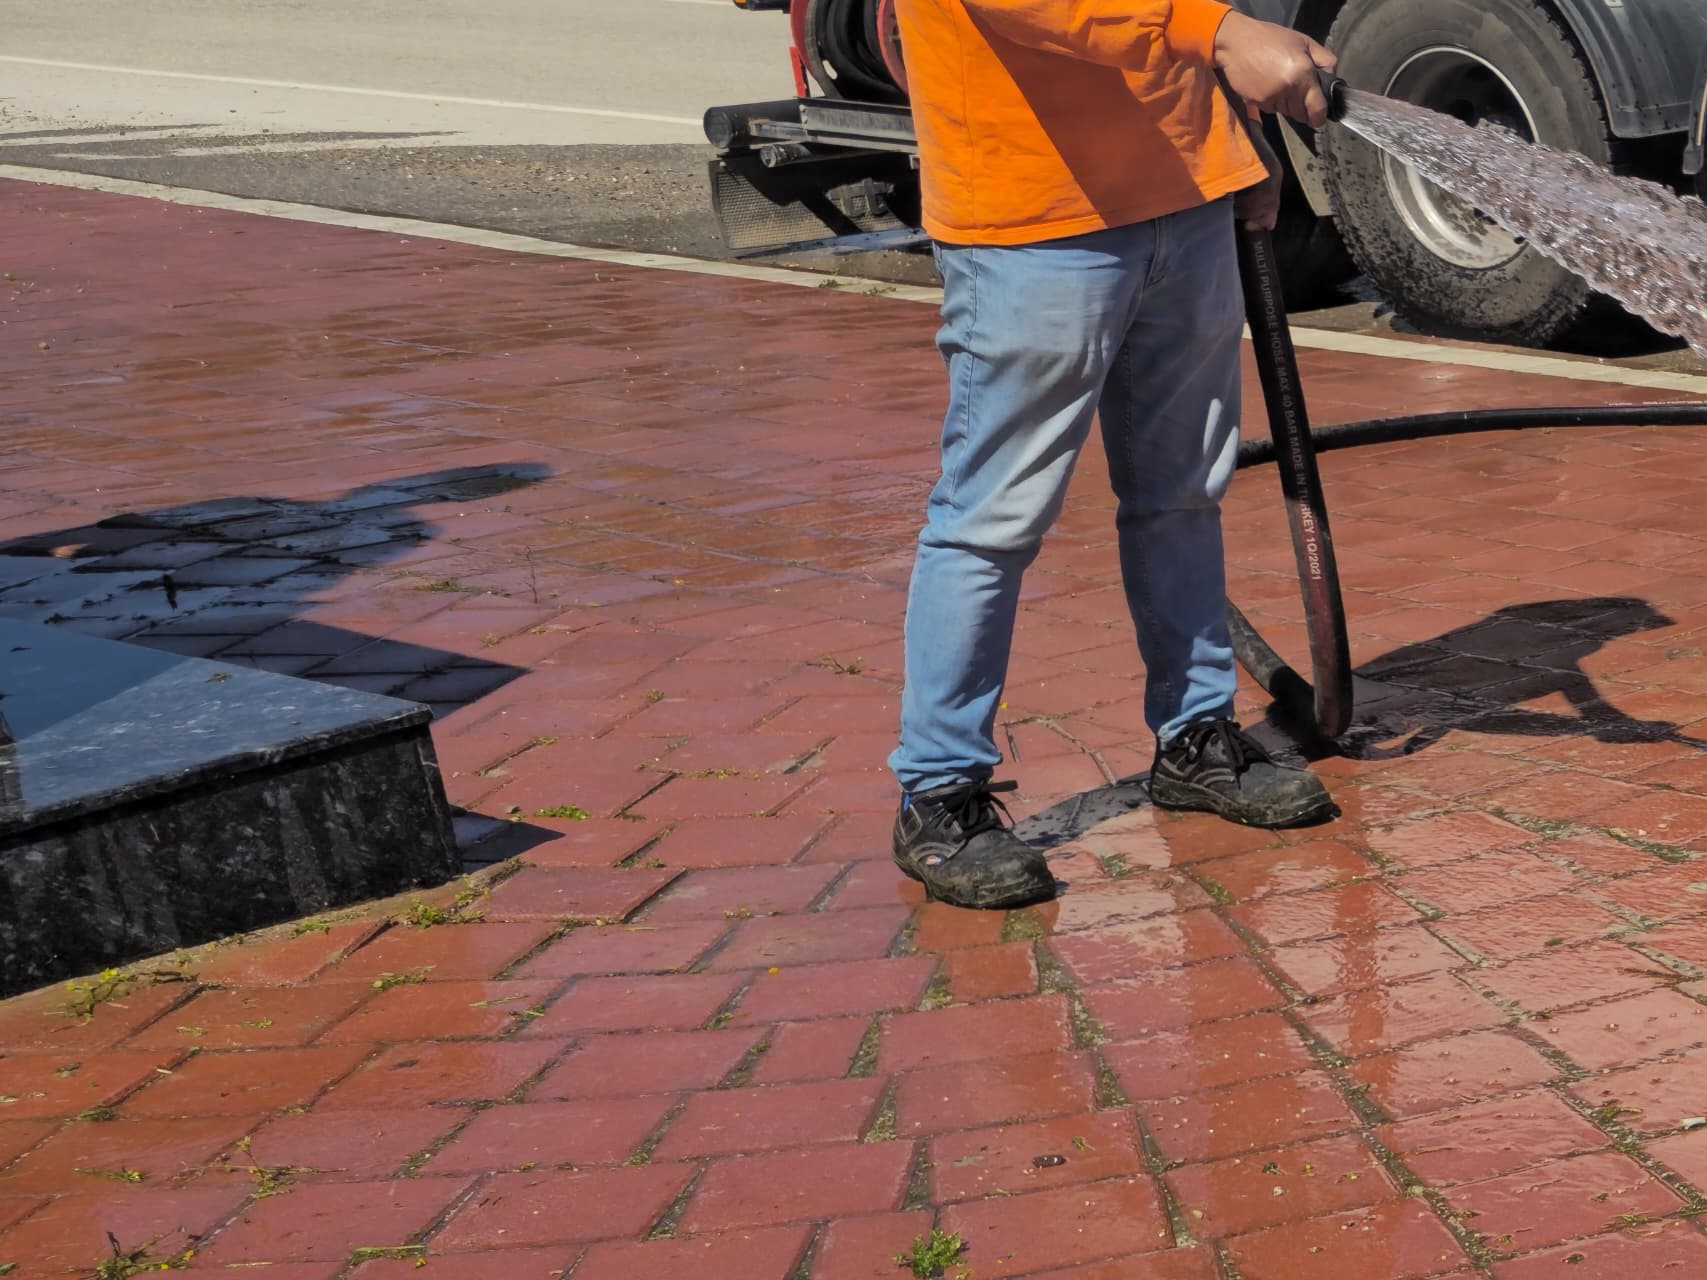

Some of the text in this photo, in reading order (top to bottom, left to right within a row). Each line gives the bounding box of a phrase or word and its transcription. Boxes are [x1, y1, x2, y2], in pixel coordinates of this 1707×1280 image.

[1254, 240, 1266, 274] MULTI
[1259, 274, 1280, 329] PURPOSE
[1277, 366, 1291, 392] MAX
[1283, 408, 1299, 435] BAR
[1288, 435, 1305, 470] MADE
[1298, 488, 1316, 535] TURKEY
